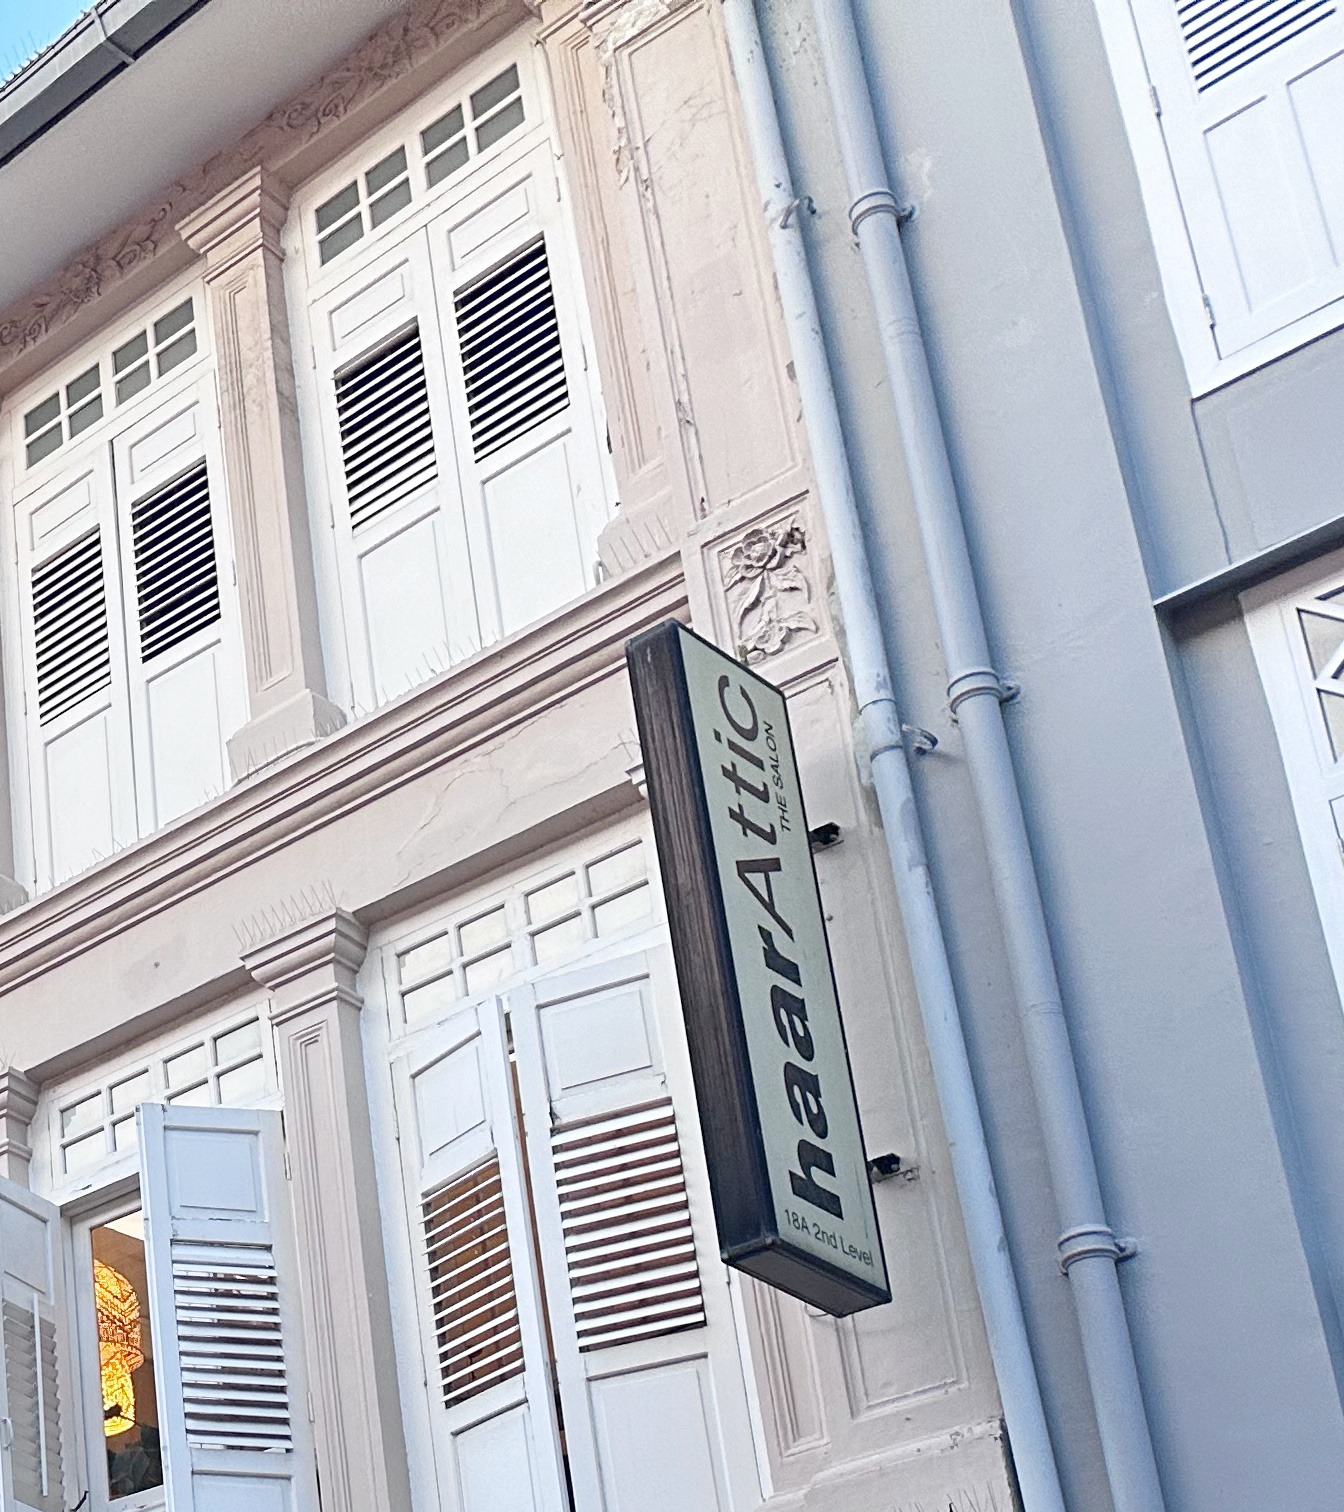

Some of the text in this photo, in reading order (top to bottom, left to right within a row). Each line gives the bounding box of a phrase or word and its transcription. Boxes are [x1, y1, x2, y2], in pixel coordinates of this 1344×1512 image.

[763, 720, 792, 833] THE SALON
[784, 1208, 874, 1267] 18A 2nd Level
